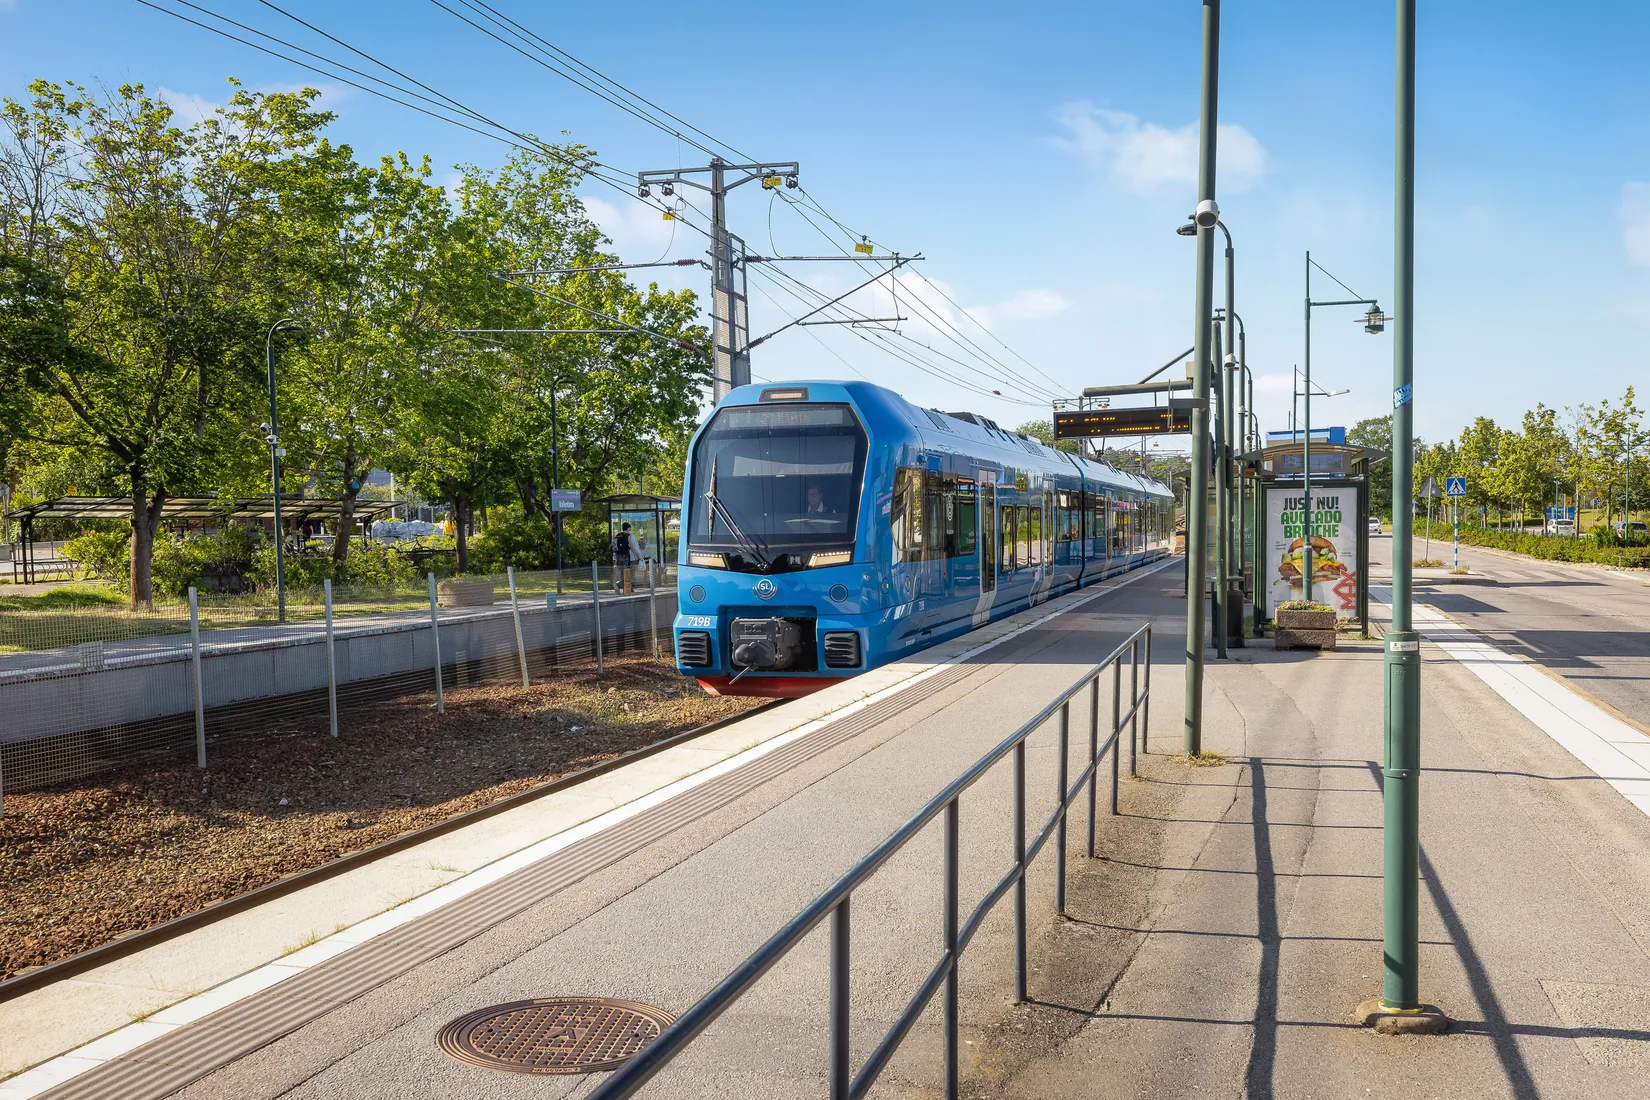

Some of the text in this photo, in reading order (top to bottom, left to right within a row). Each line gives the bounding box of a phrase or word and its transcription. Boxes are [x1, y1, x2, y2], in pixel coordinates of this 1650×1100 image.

[1316, 496, 1340, 510] NU!
[1281, 510, 1343, 525] AVOCADO
[1283, 524, 1340, 539] BRIOCHE
[760, 583, 771, 591] SL
[1332, 568, 1357, 610] MAX
[687, 616, 711, 627] 719B
